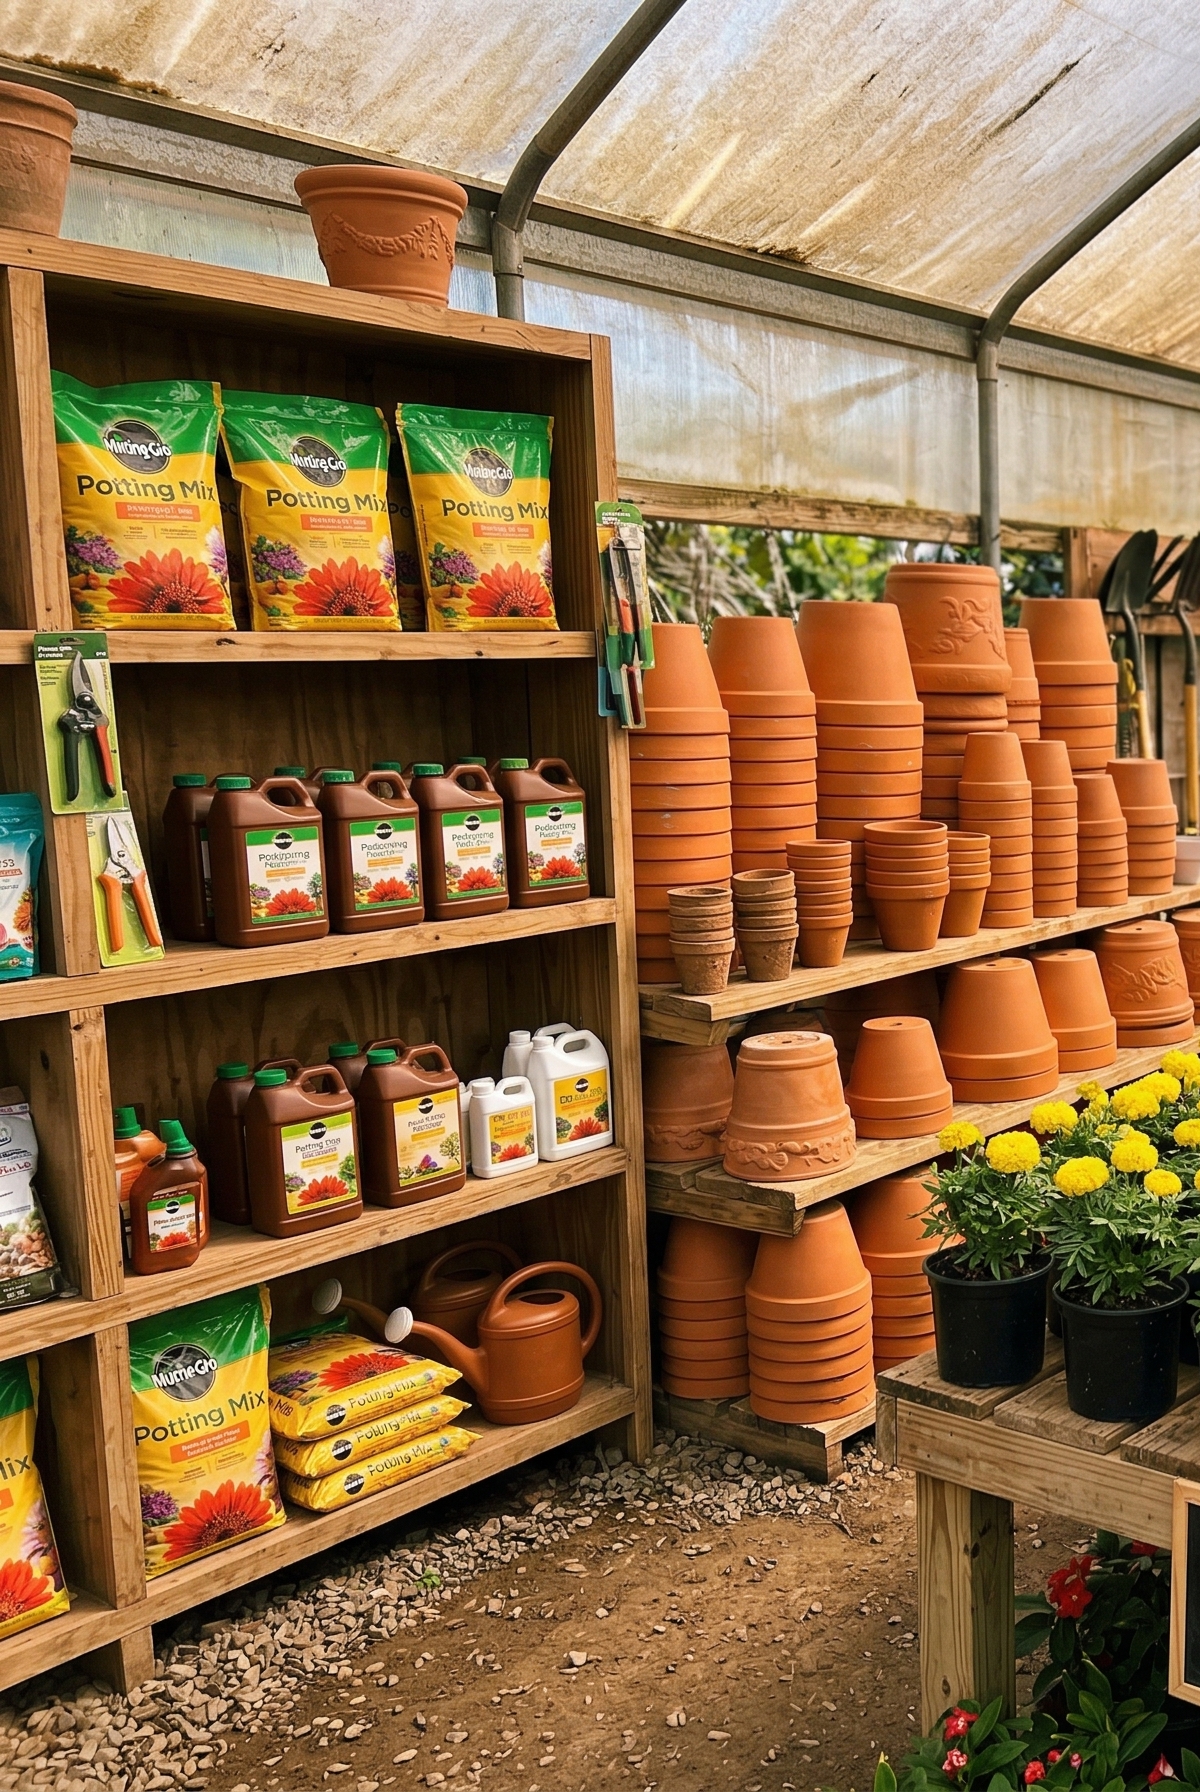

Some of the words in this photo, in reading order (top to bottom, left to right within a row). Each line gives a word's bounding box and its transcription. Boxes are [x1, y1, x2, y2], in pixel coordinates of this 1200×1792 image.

[77, 475, 176, 502] Potting
[179, 481, 216, 502] Mix
[266, 489, 351, 514] Potting
[354, 494, 387, 512] Mix
[442, 498, 515, 522] Potting
[517, 502, 549, 519] Mix
[134, 1406, 225, 1446] Potting
[228, 1390, 266, 1417] Mix
